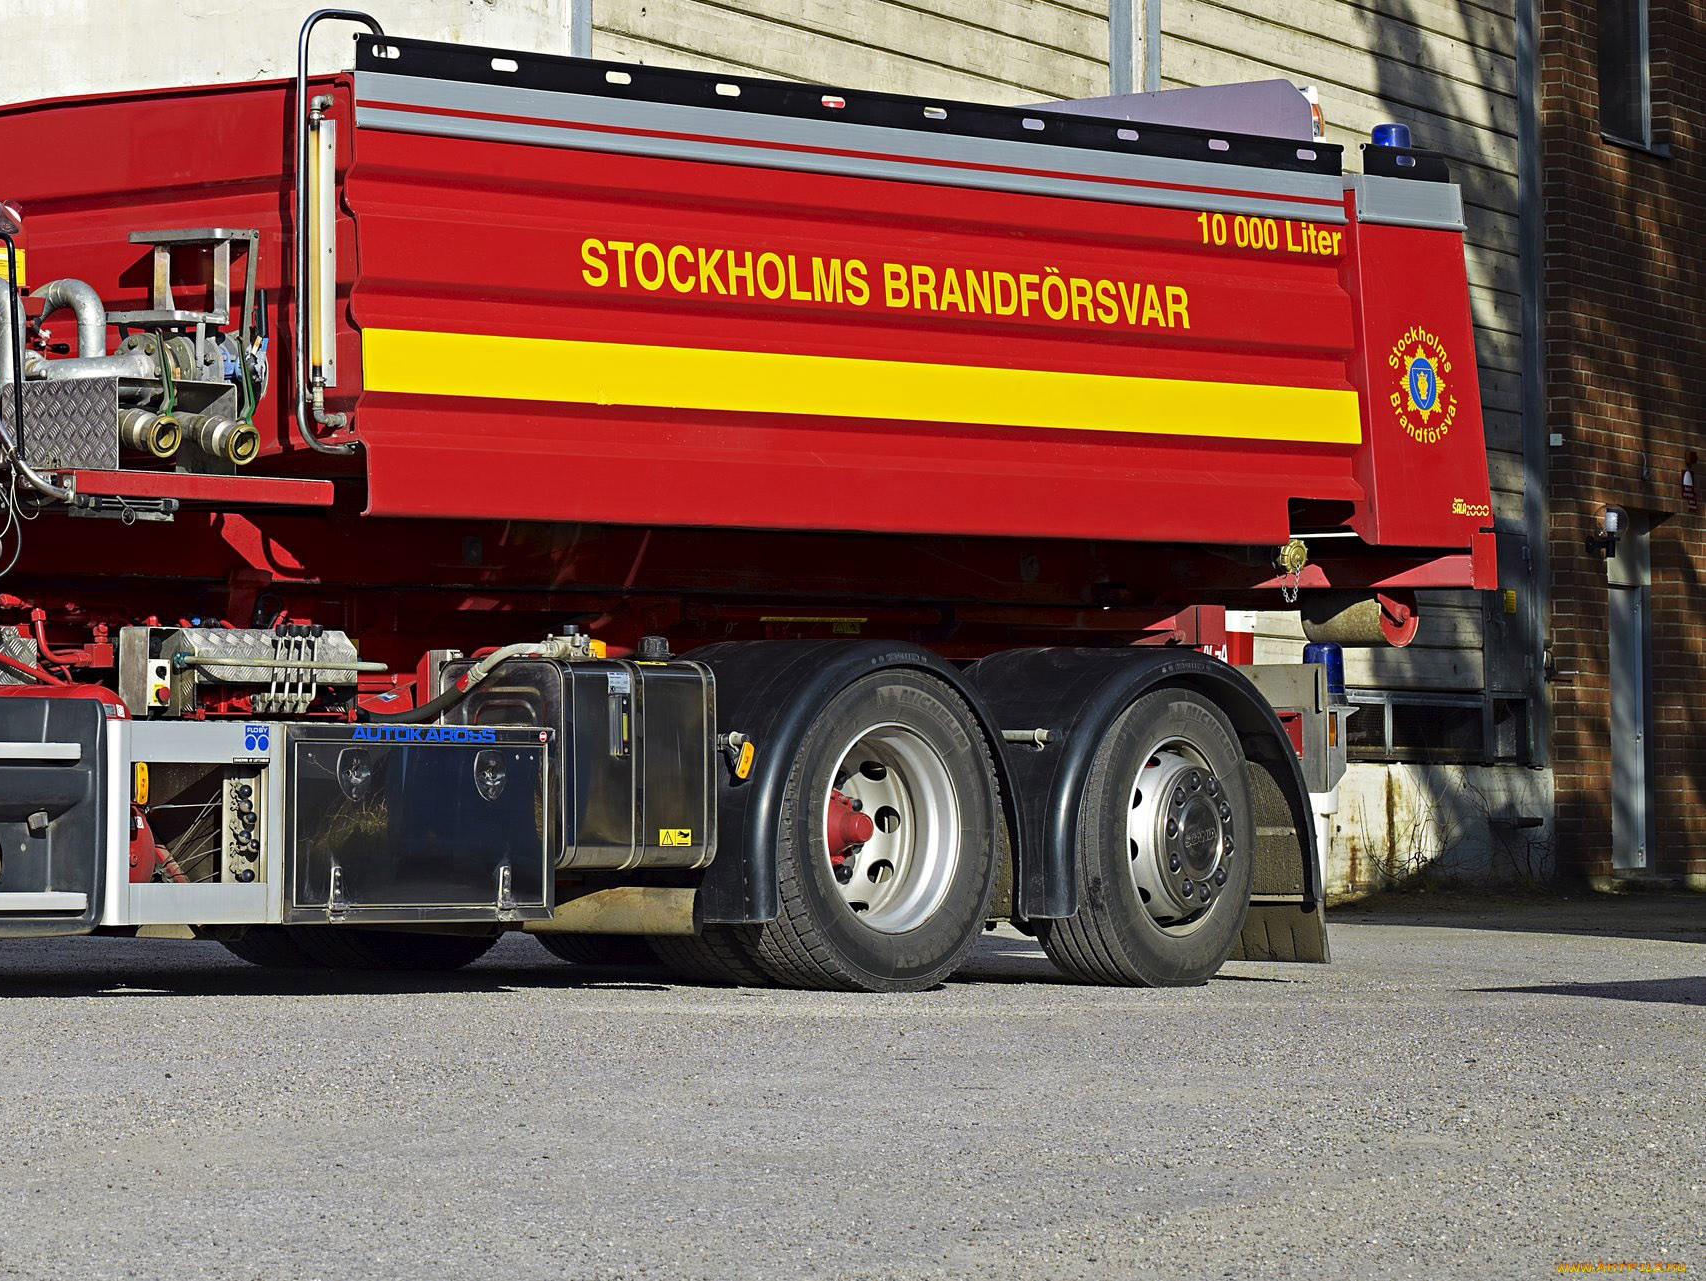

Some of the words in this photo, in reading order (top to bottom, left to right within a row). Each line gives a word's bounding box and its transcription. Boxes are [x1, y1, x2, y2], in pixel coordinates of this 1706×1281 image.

[1197, 212, 1227, 246] 10
[1233, 215, 1279, 251] 000
[1285, 220, 1342, 256] Liter
[581, 238, 870, 306] STOCKHOLMS
[884, 263, 1191, 329] BRANDFÖRSVAR
[1388, 326, 1452, 373] Stockholms
[1390, 392, 1458, 444] Brandförsvar
[1184, 828, 1218, 848] SCANIA
